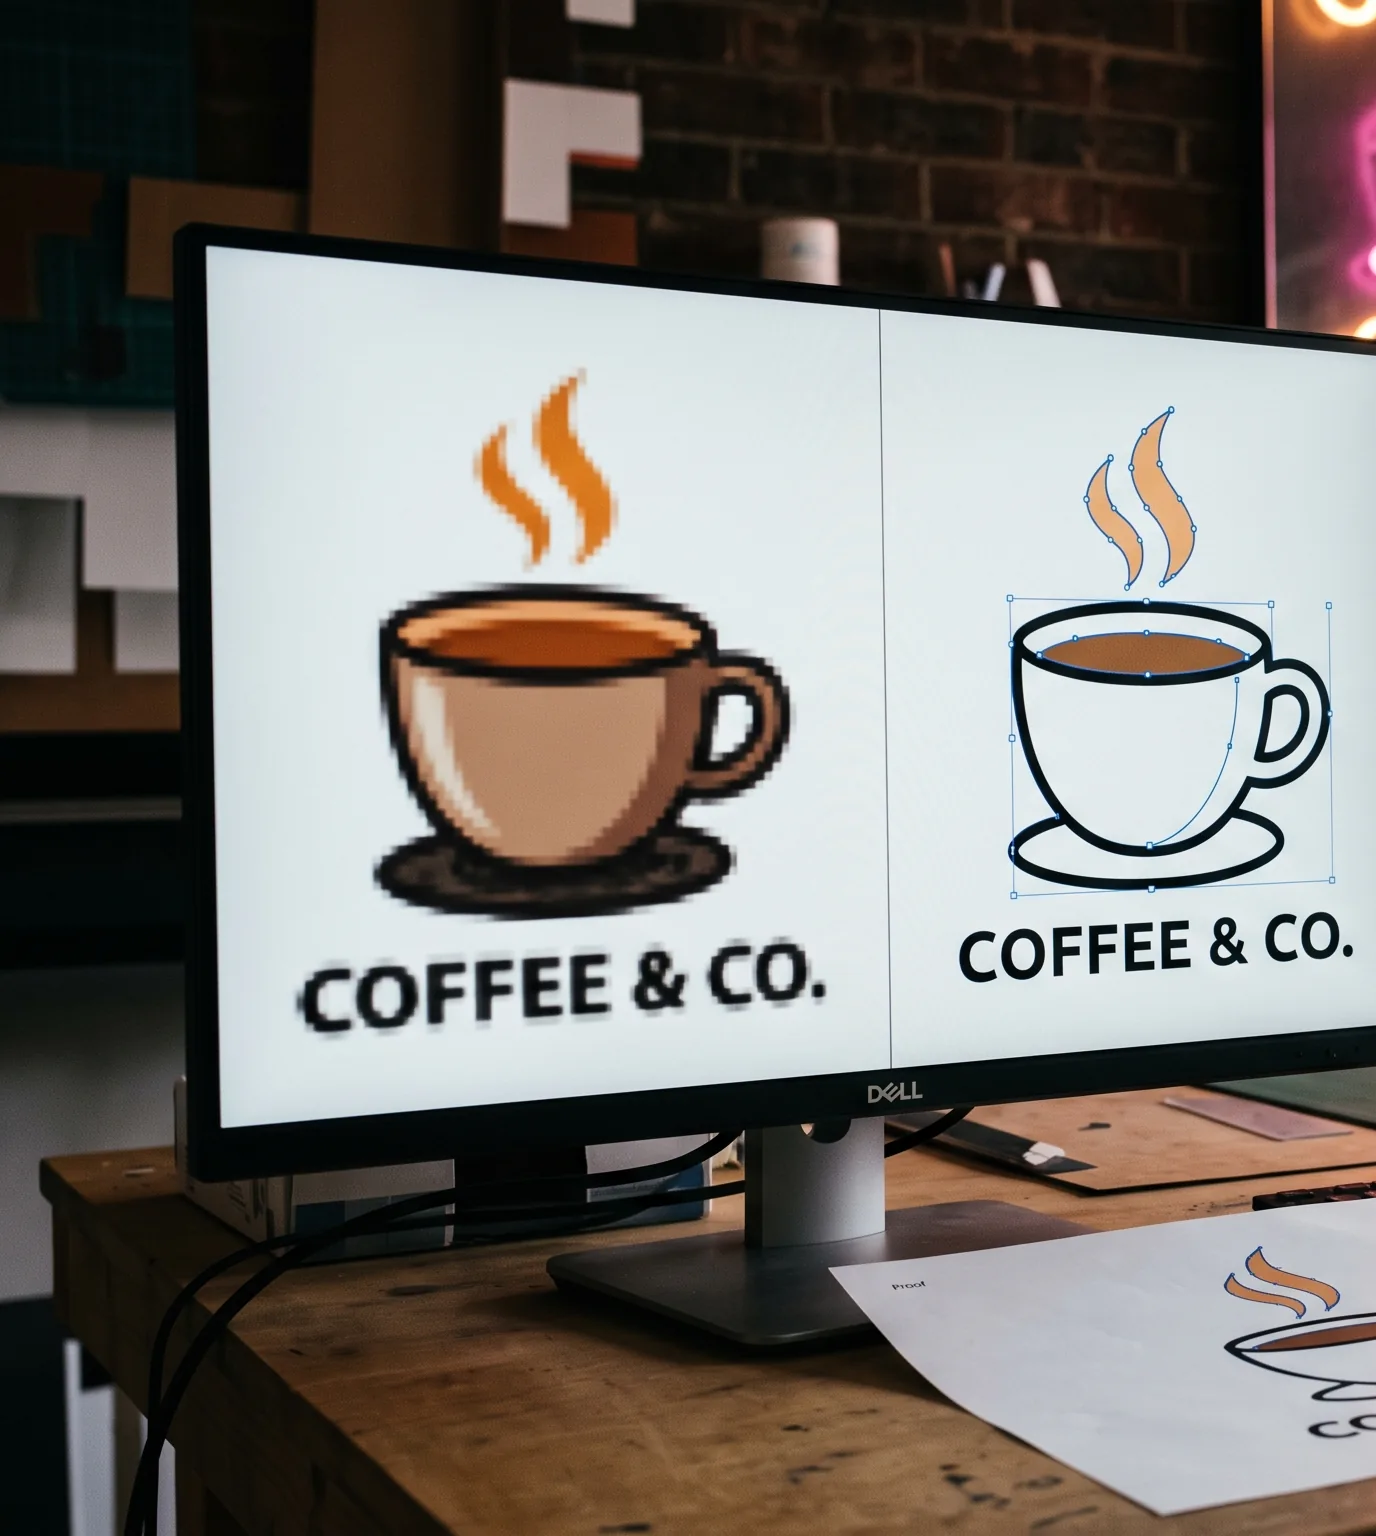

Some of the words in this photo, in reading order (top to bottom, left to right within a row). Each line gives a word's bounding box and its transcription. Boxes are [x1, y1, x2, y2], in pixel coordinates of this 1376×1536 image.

[959, 919, 1192, 983] COFFEE
[1209, 916, 1249, 967] &
[1264, 911, 1354, 963] CO.
[296, 951, 613, 1038] COFFEE
[631, 944, 689, 1015] &
[705, 938, 827, 1011] CO.
[867, 1081, 924, 1104] DELL
[891, 1280, 926, 1291] Proof
